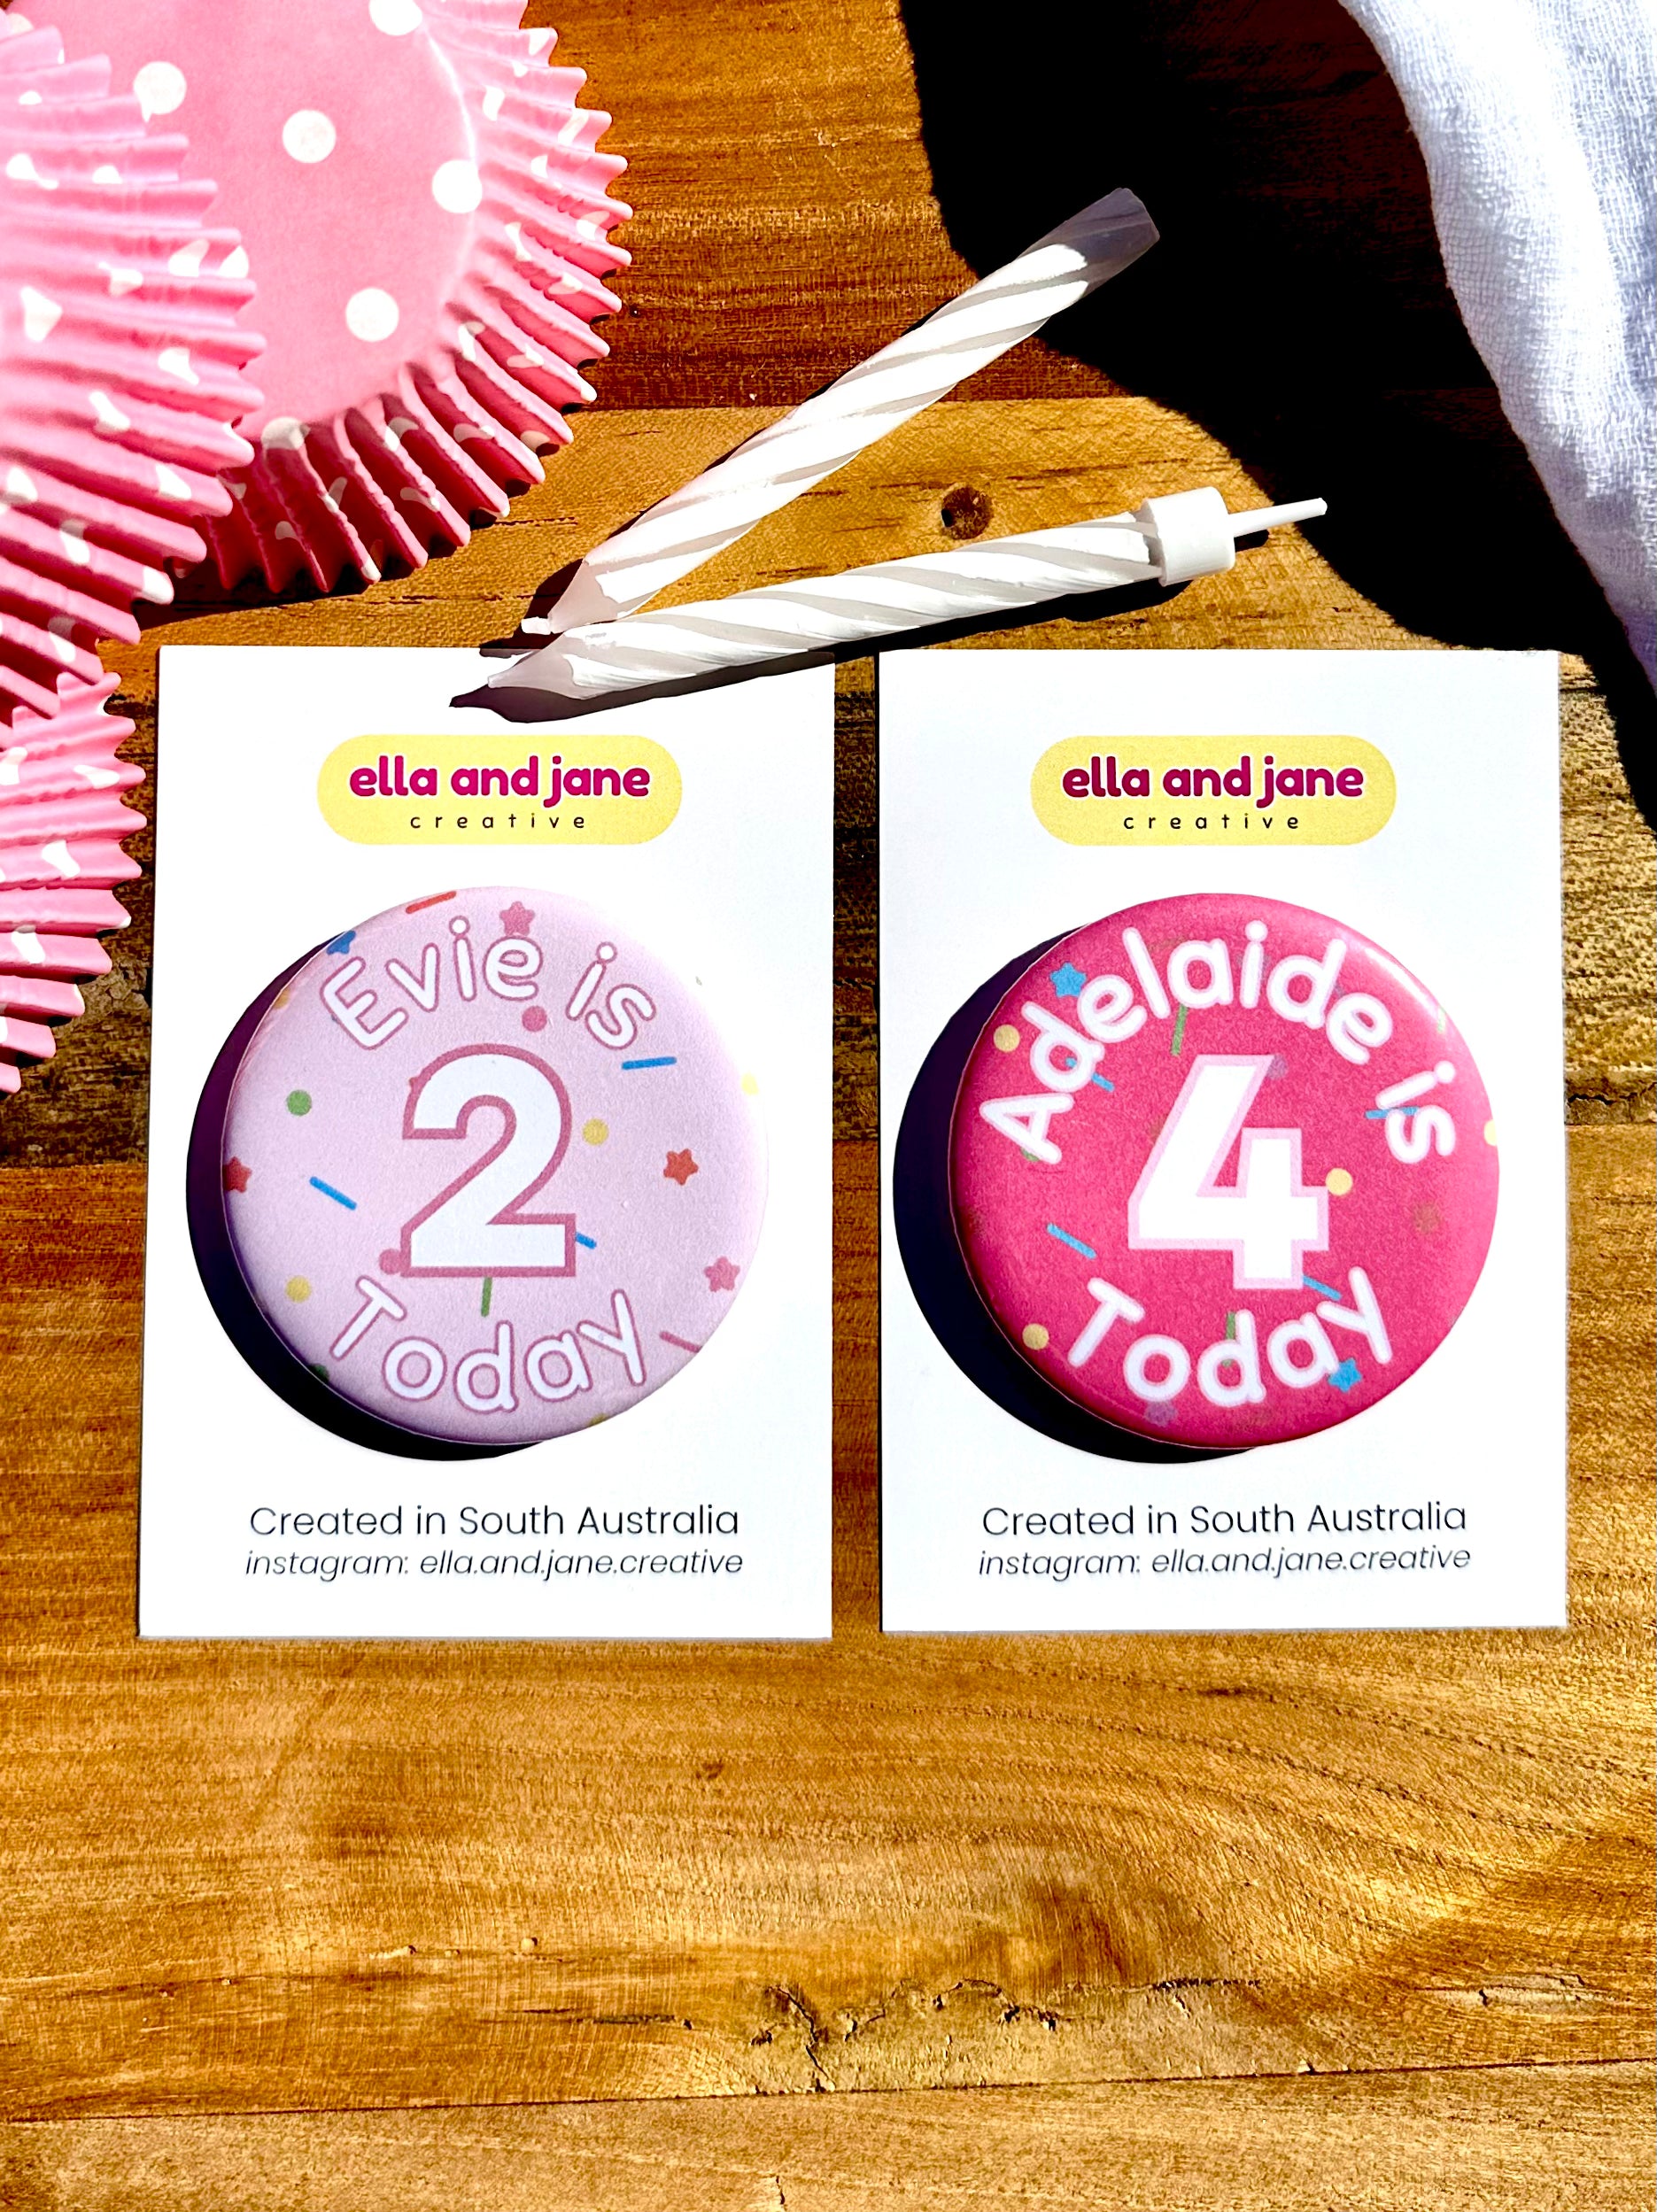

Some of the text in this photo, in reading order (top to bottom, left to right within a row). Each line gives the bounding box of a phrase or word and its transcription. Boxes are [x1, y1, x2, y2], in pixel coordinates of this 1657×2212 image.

[350, 755, 650, 808] ella and jane
[1063, 756, 1364, 808] ella and jane
[410, 813, 585, 829] creative
[1124, 813, 1298, 829] creative
[320, 915, 656, 1050] Evie is
[979, 920, 1455, 1164] Adelaide is
[400, 1042, 576, 1277] 2
[1127, 1054, 1329, 1289] 4
[330, 1275, 646, 1413] Today
[1067, 1266, 1392, 1406] Today
[250, 1504, 739, 1535] Created in South Australia
[982, 1501, 1466, 1535] Created in South Australia
[245, 1549, 743, 1582] instagram: ella.and.jane.creative
[979, 1544, 1471, 1582] instagram: ella.and.jane.creative
